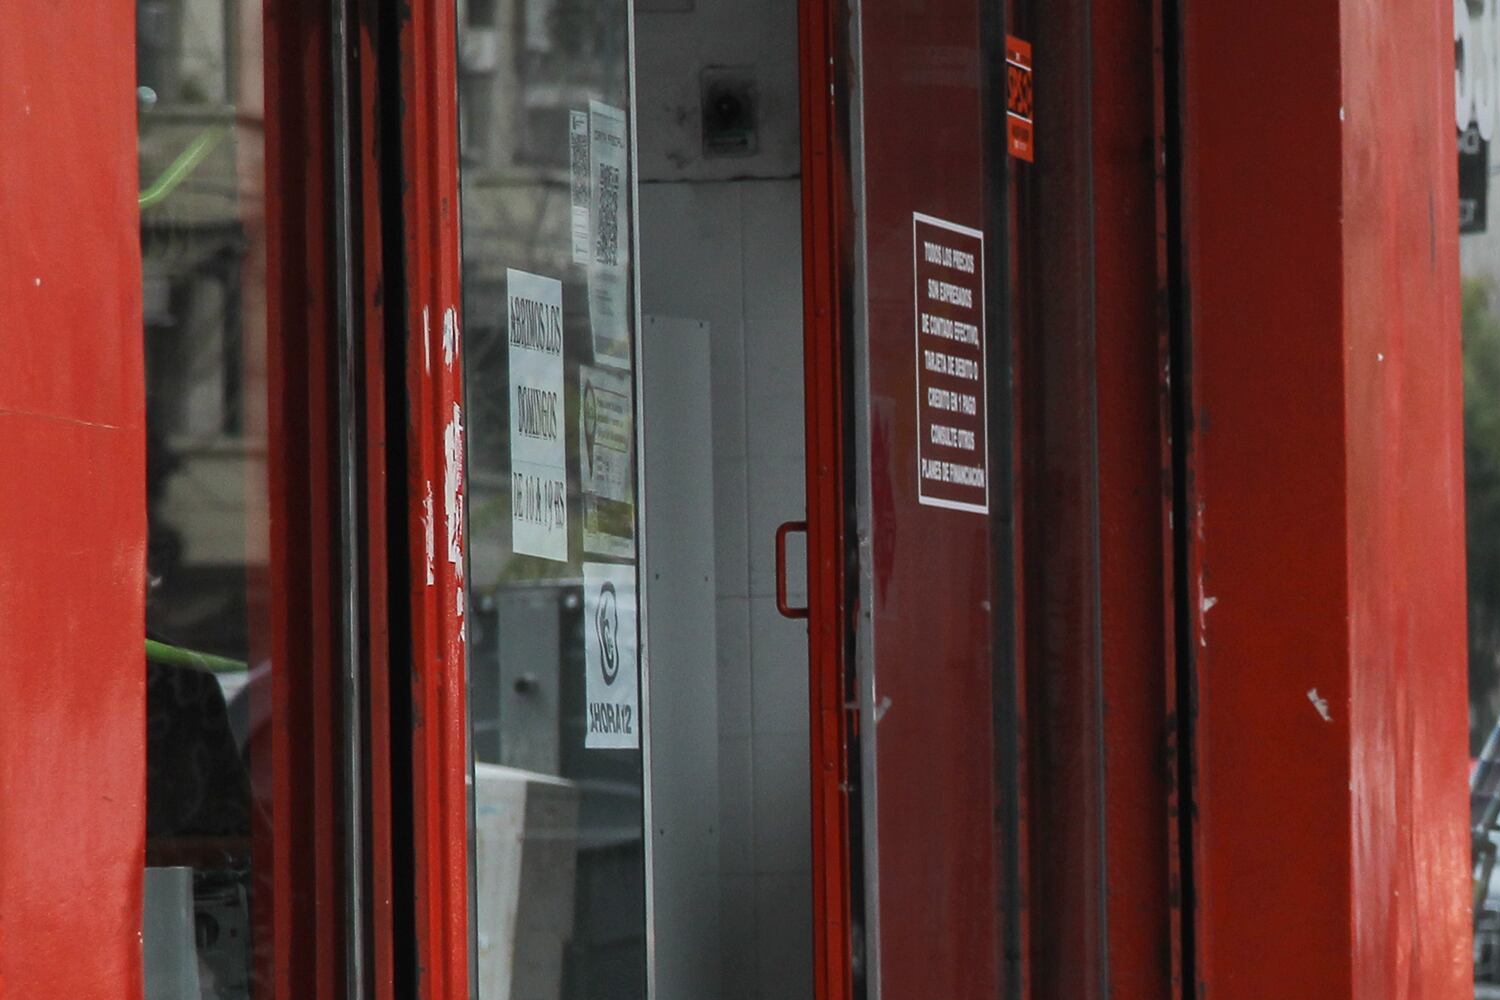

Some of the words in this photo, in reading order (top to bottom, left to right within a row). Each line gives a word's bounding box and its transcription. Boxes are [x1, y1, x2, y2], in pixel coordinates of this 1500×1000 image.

[924, 241, 942, 265] TODOS
[942, 246, 953, 268] LOS
[953, 249, 975, 274] PRECIOS
[928, 278, 939, 299] SON
[940, 281, 973, 309] EXPRESADOS
[509, 296, 545, 353] ABRIMOS
[545, 304, 562, 356] LOS
[921, 313, 930, 334] DE
[930, 315, 953, 340] CONTADO
[924, 349, 947, 374] TARJETA
[947, 355, 955, 376] DE
[974, 361, 979, 381] O
[518, 385, 557, 440] DOMINGOS
[928, 387, 950, 411] CREDITO
[950, 391, 958, 412] EN
[962, 394, 977, 416] PAGO
[931, 424, 957, 448] CONSULTE
[958, 429, 975, 451] OTROS
[921, 458, 942, 481] PLANES
[942, 461, 950, 482] DE
[514, 471, 523, 521] DE
[526, 474, 534, 524] 10
[535, 477, 542, 526] A
[544, 478, 553, 531] 19
